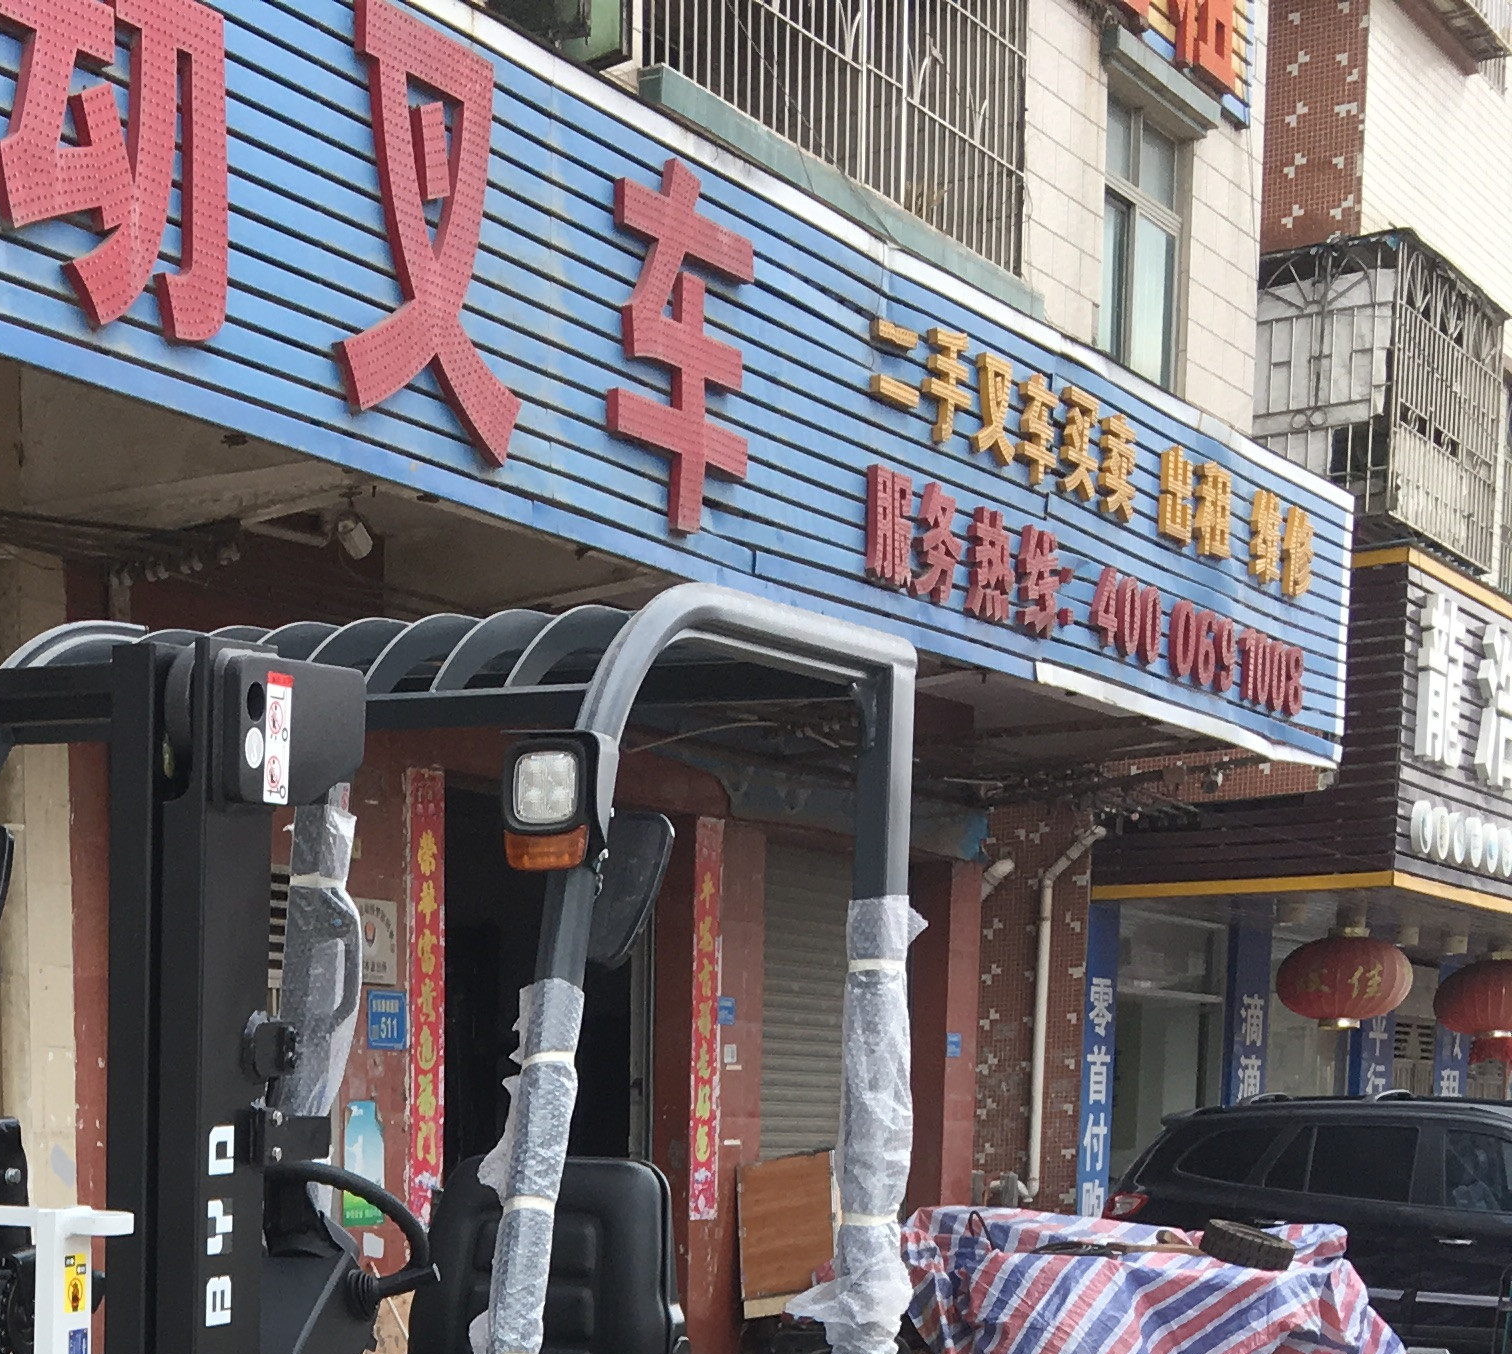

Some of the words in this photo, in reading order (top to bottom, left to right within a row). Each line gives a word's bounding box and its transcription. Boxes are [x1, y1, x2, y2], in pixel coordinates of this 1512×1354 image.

[869, 316, 1137, 523] 二手叉车买卖
[1158, 445, 1231, 560] 出租
[1090, 566, 1162, 666] 400
[1169, 599, 1236, 693] 069
[1239, 627, 1305, 717] 1008
[380, 1016, 398, 1039] 511
[205, 1124, 235, 1328] BYD
